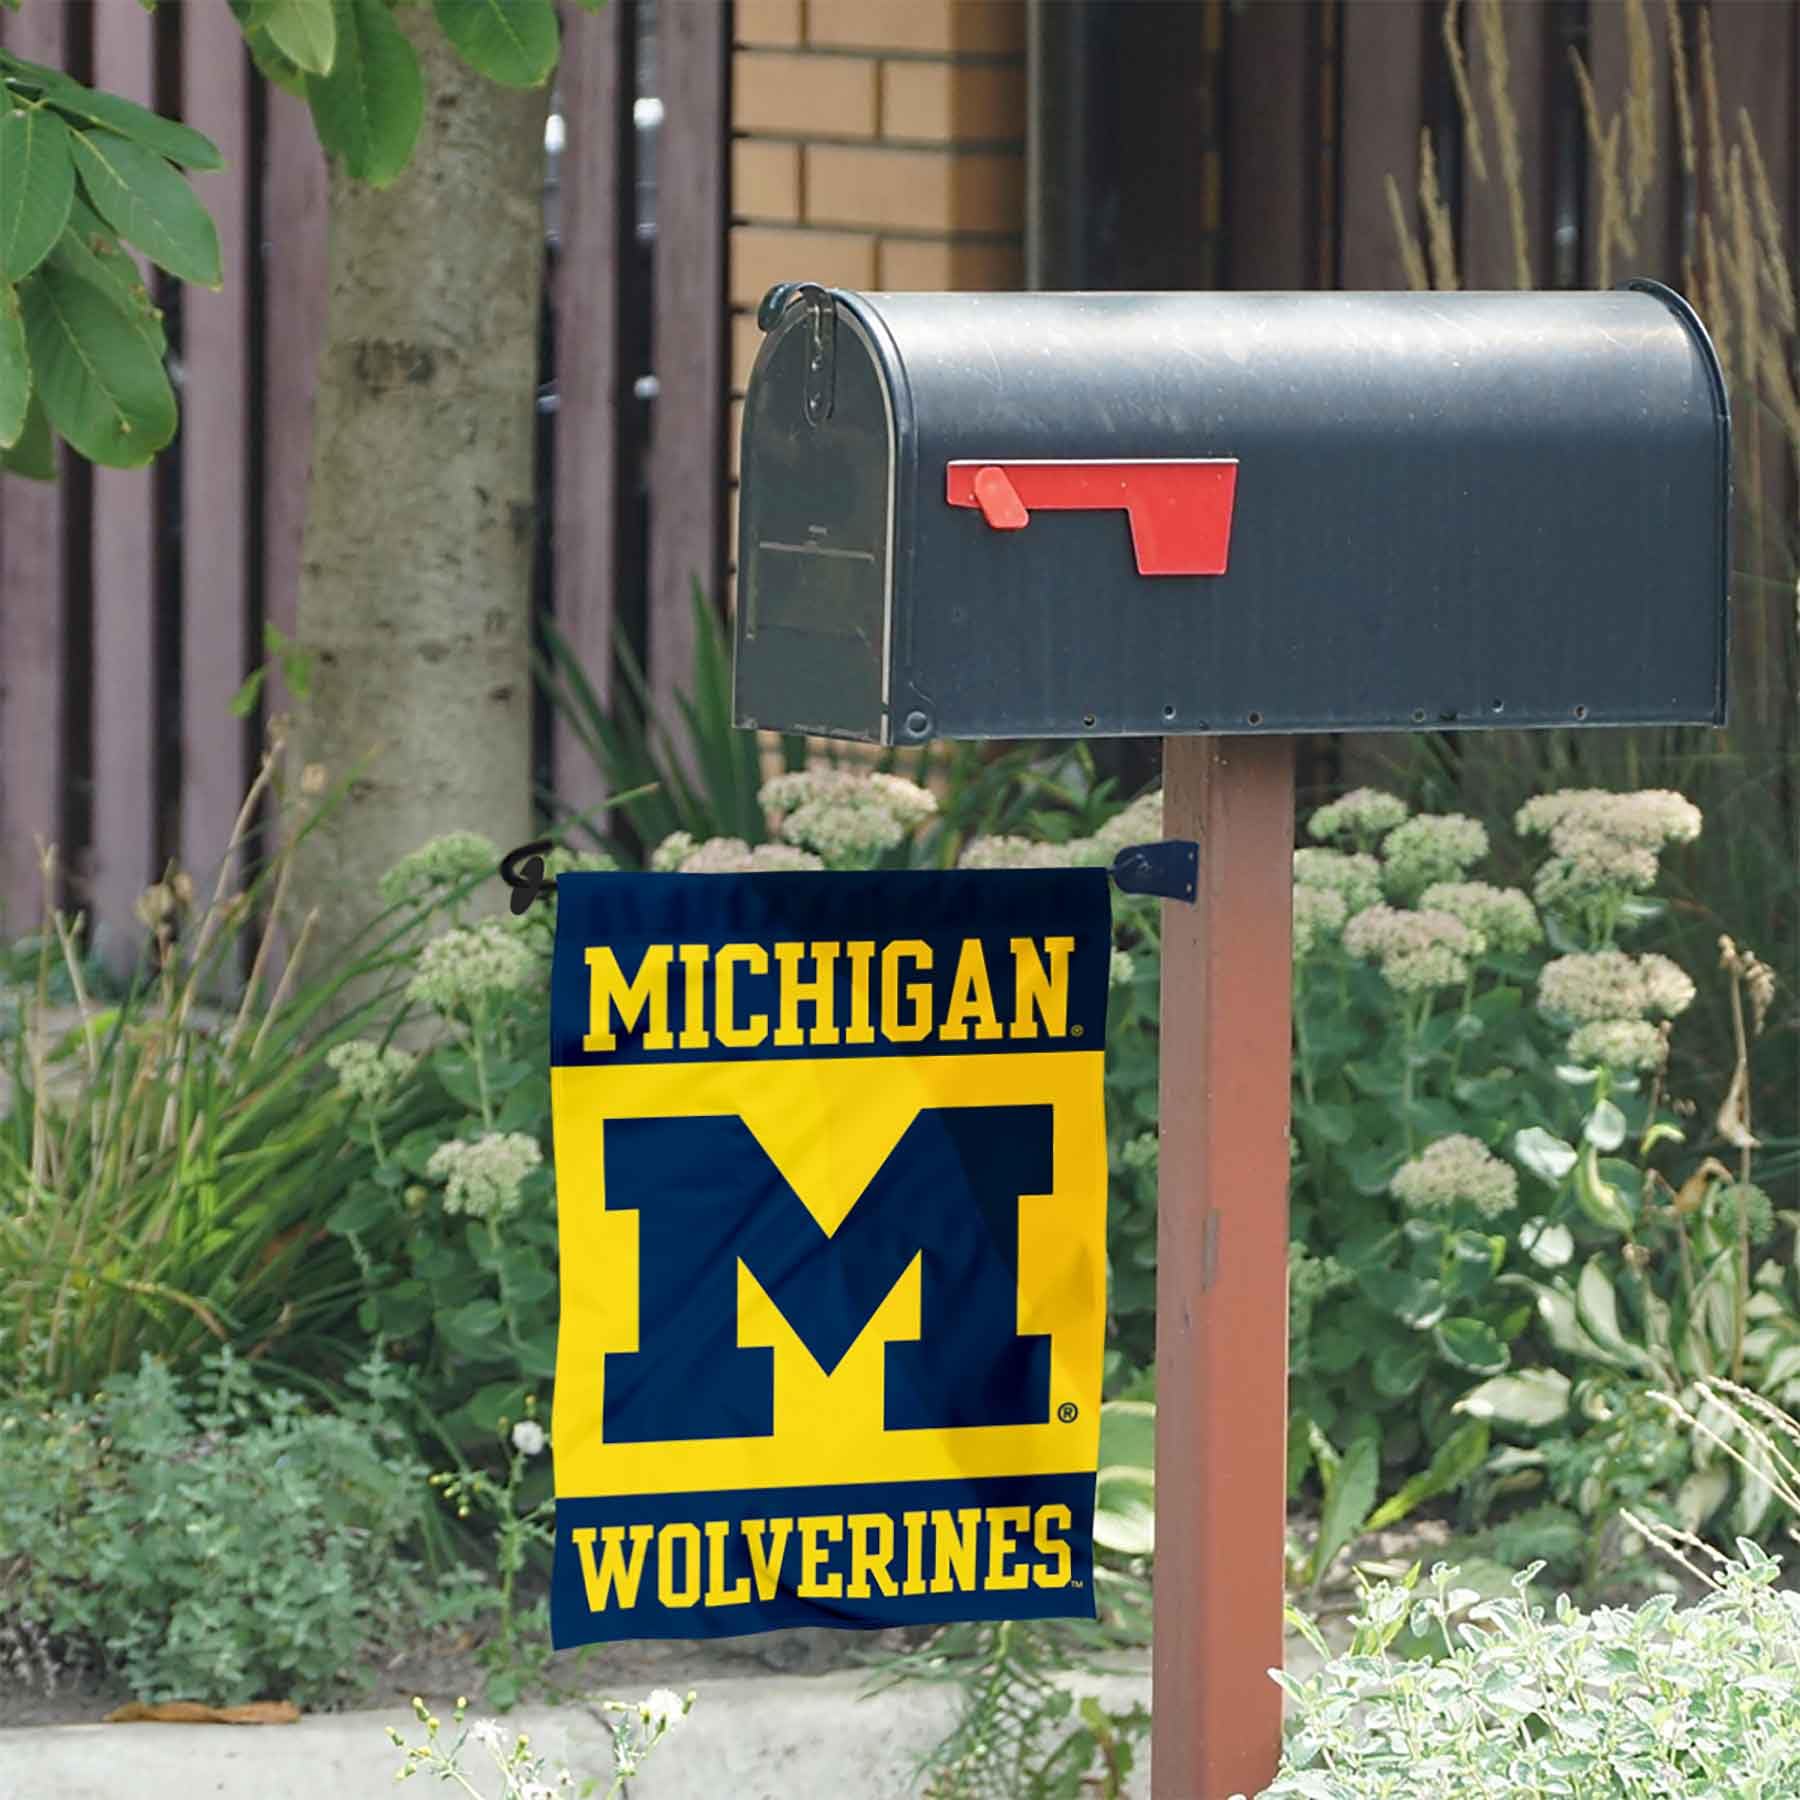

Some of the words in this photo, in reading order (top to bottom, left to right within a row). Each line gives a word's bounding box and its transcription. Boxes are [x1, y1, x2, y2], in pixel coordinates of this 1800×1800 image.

[583, 936, 1075, 1052] MICHIGAN
[603, 1104, 1054, 1443] M
[572, 1504, 1073, 1612] WOLVERINES
